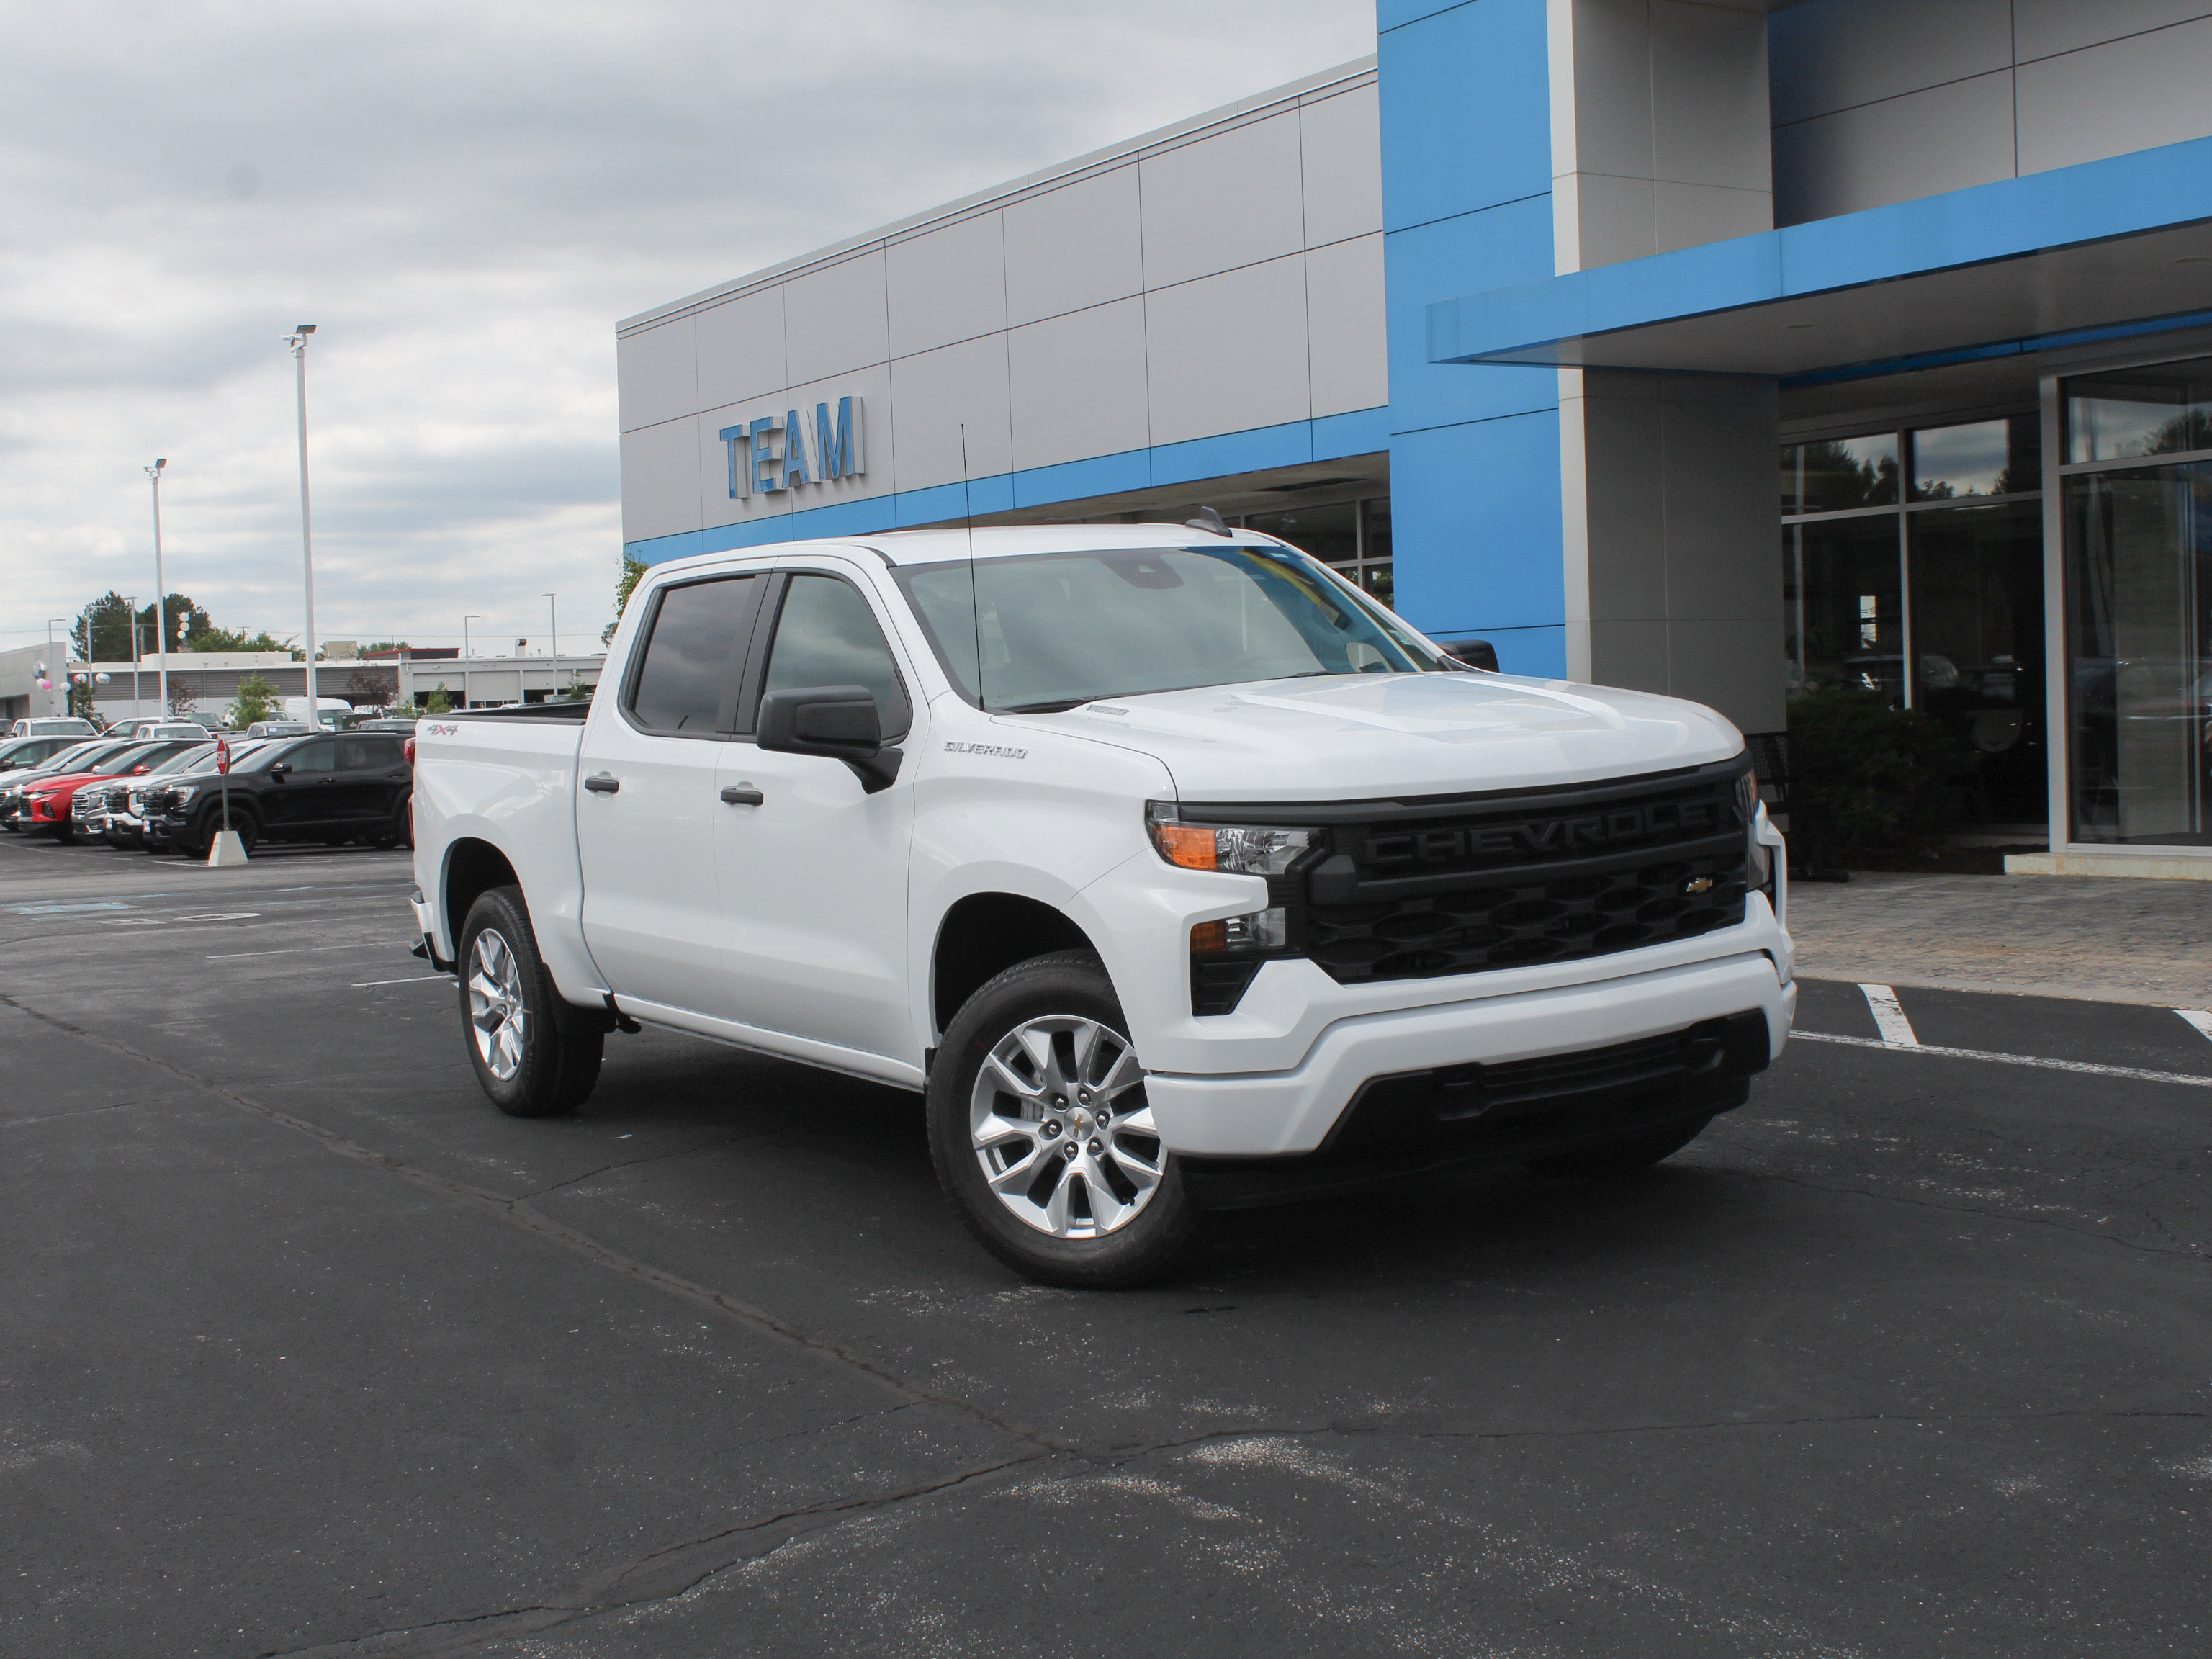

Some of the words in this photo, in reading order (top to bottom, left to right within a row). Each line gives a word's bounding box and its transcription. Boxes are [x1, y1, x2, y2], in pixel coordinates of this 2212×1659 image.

[719, 396, 860, 499] TEAM
[217, 750, 226, 764] STOP
[944, 741, 1028, 759] SILVERADO
[1364, 796, 1732, 865] CHEVROLET
